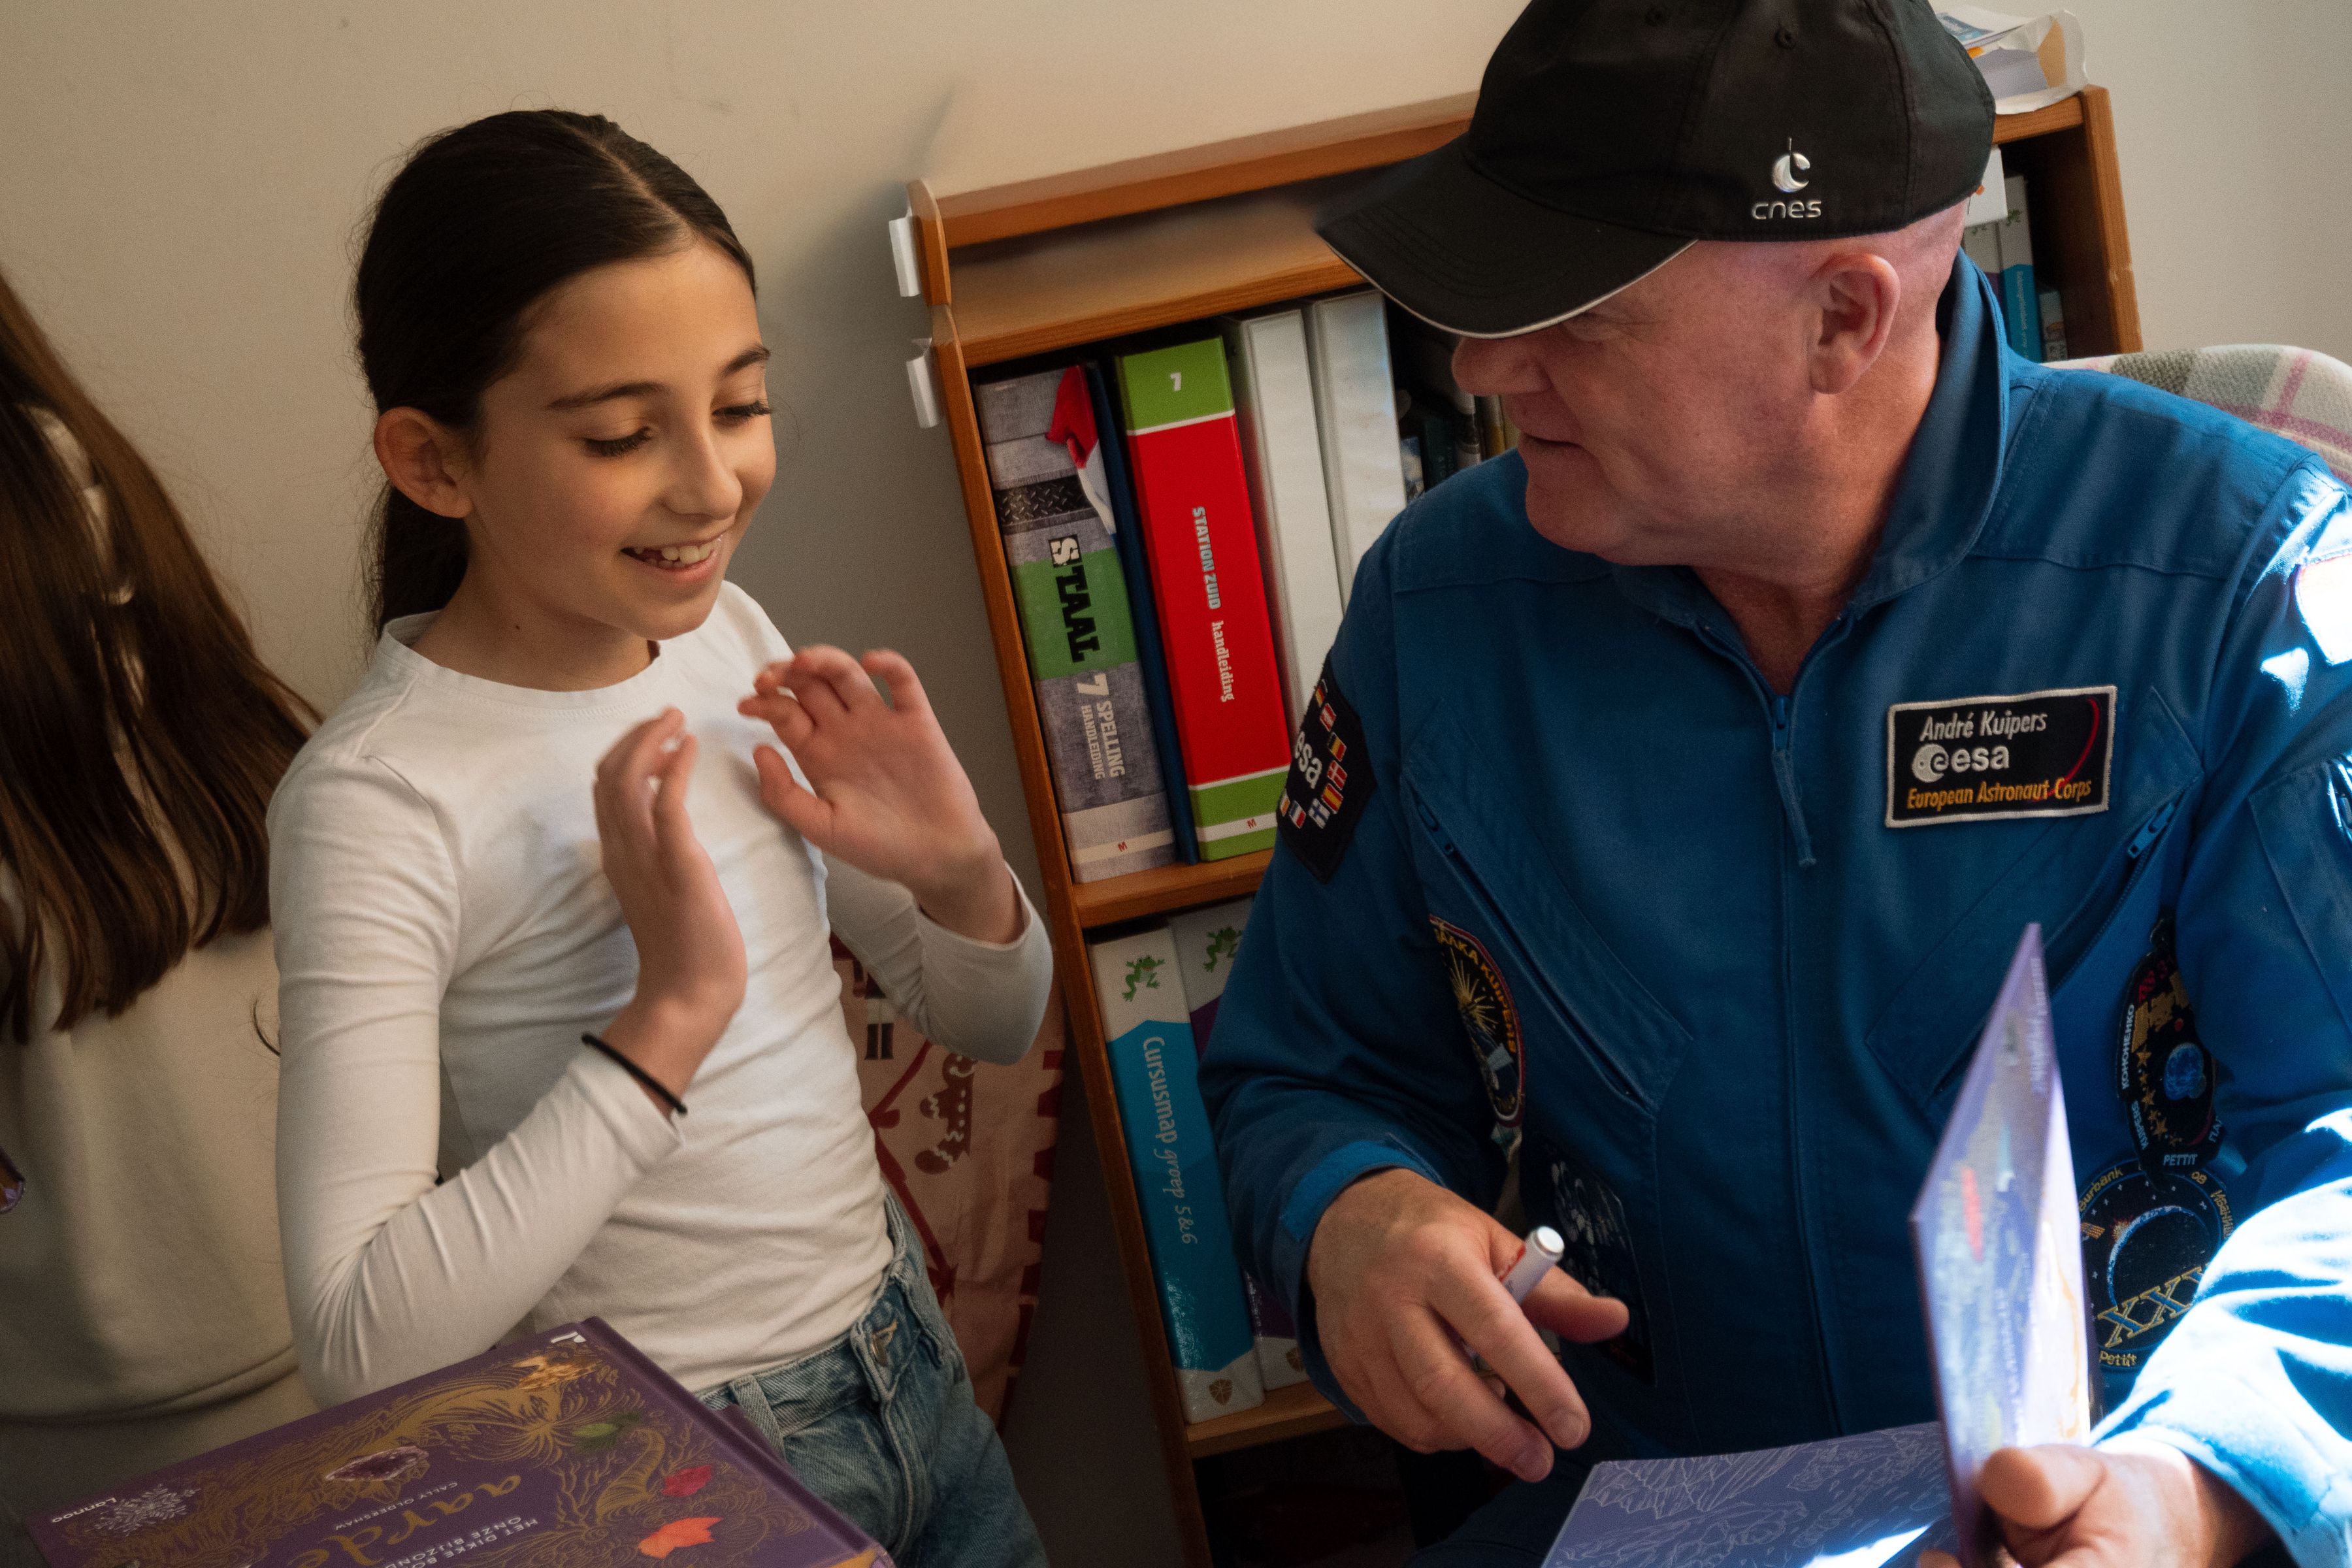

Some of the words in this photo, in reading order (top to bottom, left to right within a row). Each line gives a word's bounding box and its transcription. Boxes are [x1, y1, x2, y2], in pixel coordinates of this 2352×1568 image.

[1752, 199, 1821, 220] cnes
[1192, 506, 1215, 572] STATION
[1048, 534, 1101, 663] STAAL
[1203, 572, 1221, 610] ZUID
[1212, 620, 1235, 703] handleiding
[1077, 673, 1110, 696] 7
[1096, 700, 1126, 778] SPELLING
[1081, 704, 1105, 780] HANDLEIDING
[1919, 711, 1974, 742] André
[1979, 710, 2048, 740] Kuipers
[1294, 730, 1323, 789] esa
[1950, 745, 2010, 774] esa
[1906, 785, 1973, 812] European
[1976, 781, 2051, 804] Astronaut
[2054, 777, 2092, 803] Corps
[1247, 818, 1257, 829] M
[1143, 1036, 1178, 1144] Cursusmap
[1153, 1148, 1185, 1201] groep
[2163, 1153, 2198, 1167] PETTIT
[419, 1482, 457, 1500] CALLY
[52, 1497, 117, 1523] Lannoo
[335, 1497, 414, 1531] OLDERSHAW
[505, 1518, 538, 1536] HET
[470, 1516, 521, 1539] ONZE
[444, 1535, 498, 1559] DIKKE
